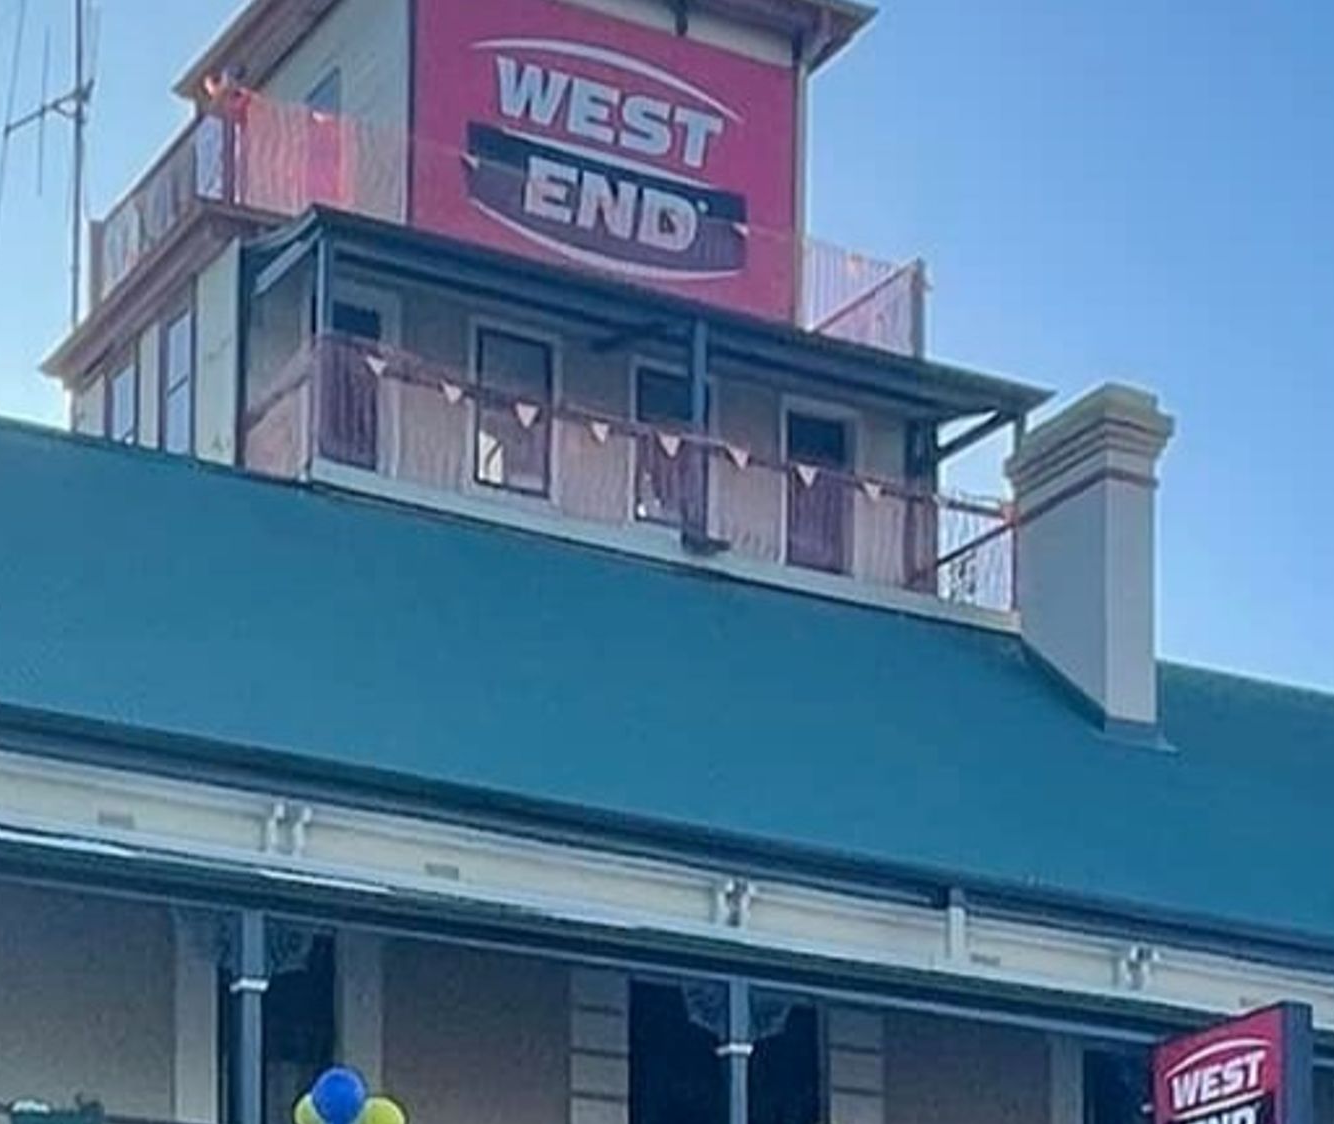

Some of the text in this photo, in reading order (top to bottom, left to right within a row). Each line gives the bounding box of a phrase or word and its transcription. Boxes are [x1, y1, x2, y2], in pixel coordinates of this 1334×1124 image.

[496, 55, 724, 168] WEST
[522, 156, 699, 252] END
[1171, 1050, 1266, 1110] WEST
